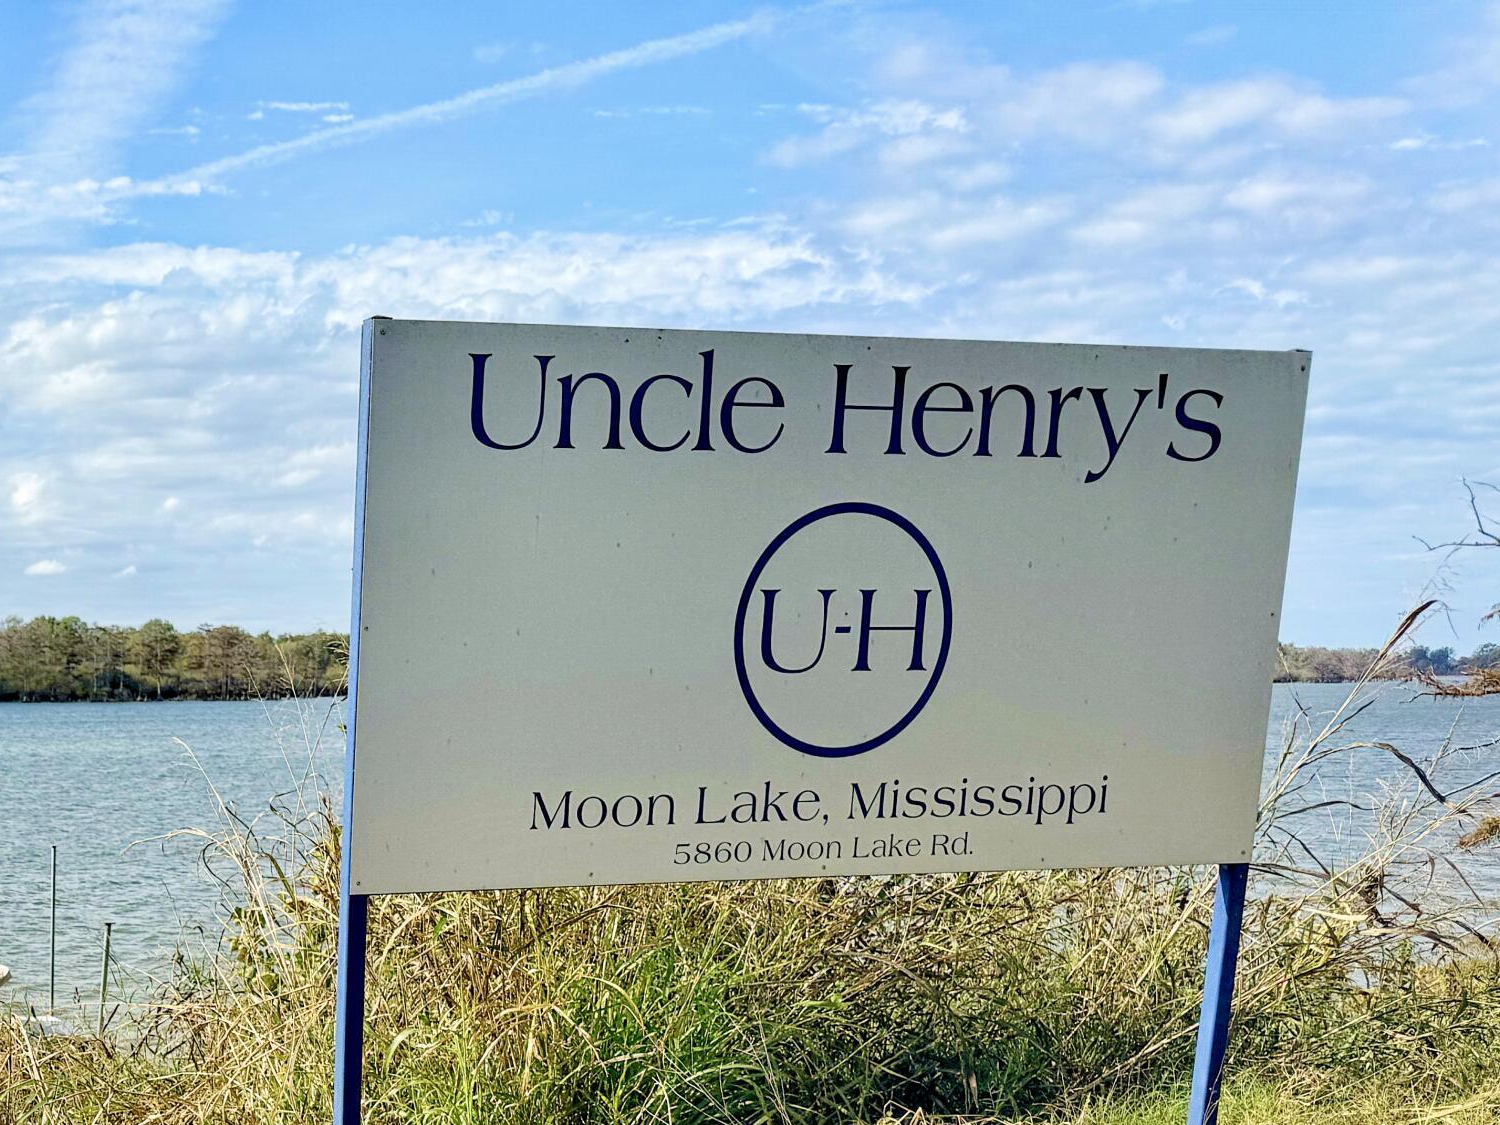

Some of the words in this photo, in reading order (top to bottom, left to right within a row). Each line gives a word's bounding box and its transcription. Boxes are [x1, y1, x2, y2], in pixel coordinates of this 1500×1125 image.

[468, 349, 785, 453] Uncle
[825, 364, 1223, 483] Henry's
[759, 589, 932, 674] U-H
[530, 791, 675, 830] Moon
[695, 781, 828, 825] Lake,
[847, 775, 1108, 825] Mississippi
[674, 841, 752, 864] 5860
[763, 839, 841, 861] Moon
[853, 834, 921, 858] Lake
[931, 832, 974, 856] Rd.
